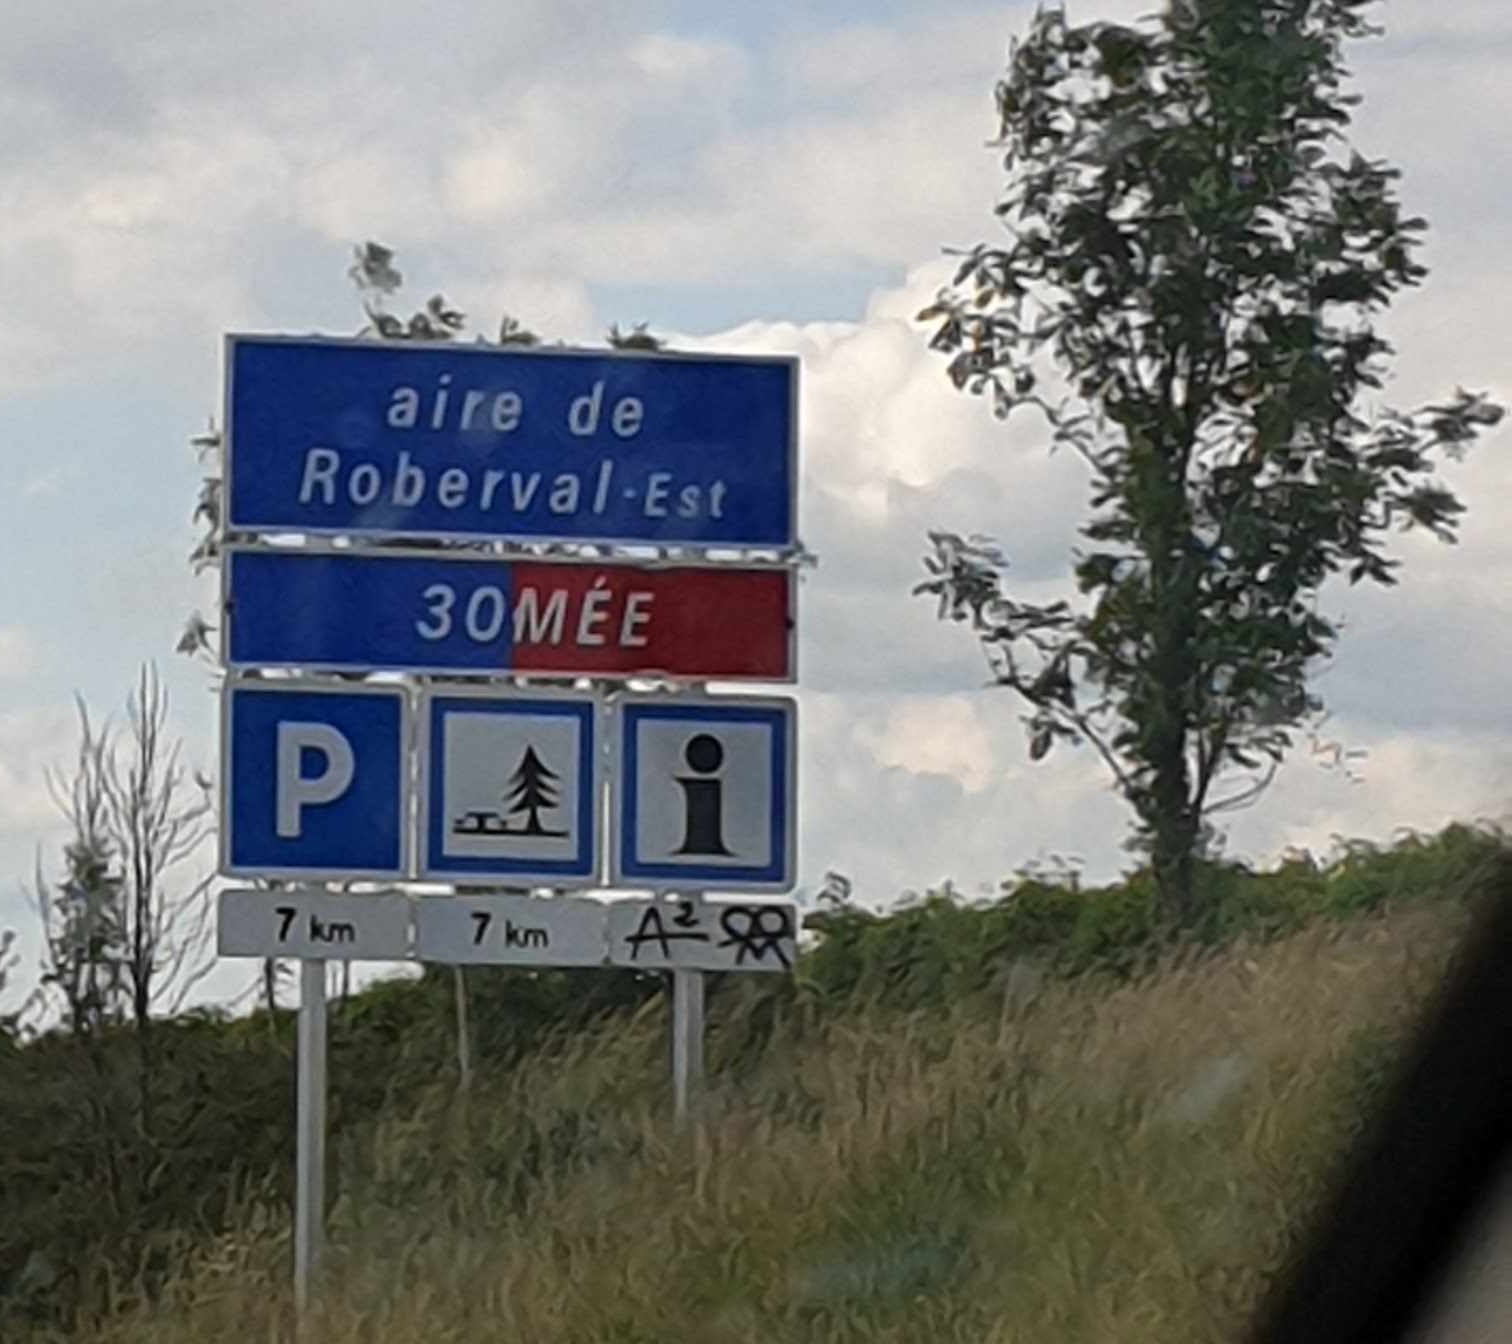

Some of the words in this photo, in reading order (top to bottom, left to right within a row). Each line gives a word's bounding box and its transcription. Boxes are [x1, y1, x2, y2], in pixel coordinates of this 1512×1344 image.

[388, 374, 524, 432] aire
[568, 380, 645, 437] de
[299, 448, 728, 520] Roberval-Est
[276, 721, 355, 838] P
[275, 907, 296, 942] 7
[309, 915, 355, 942] km
[470, 912, 491, 946] 7
[505, 920, 548, 948] km
